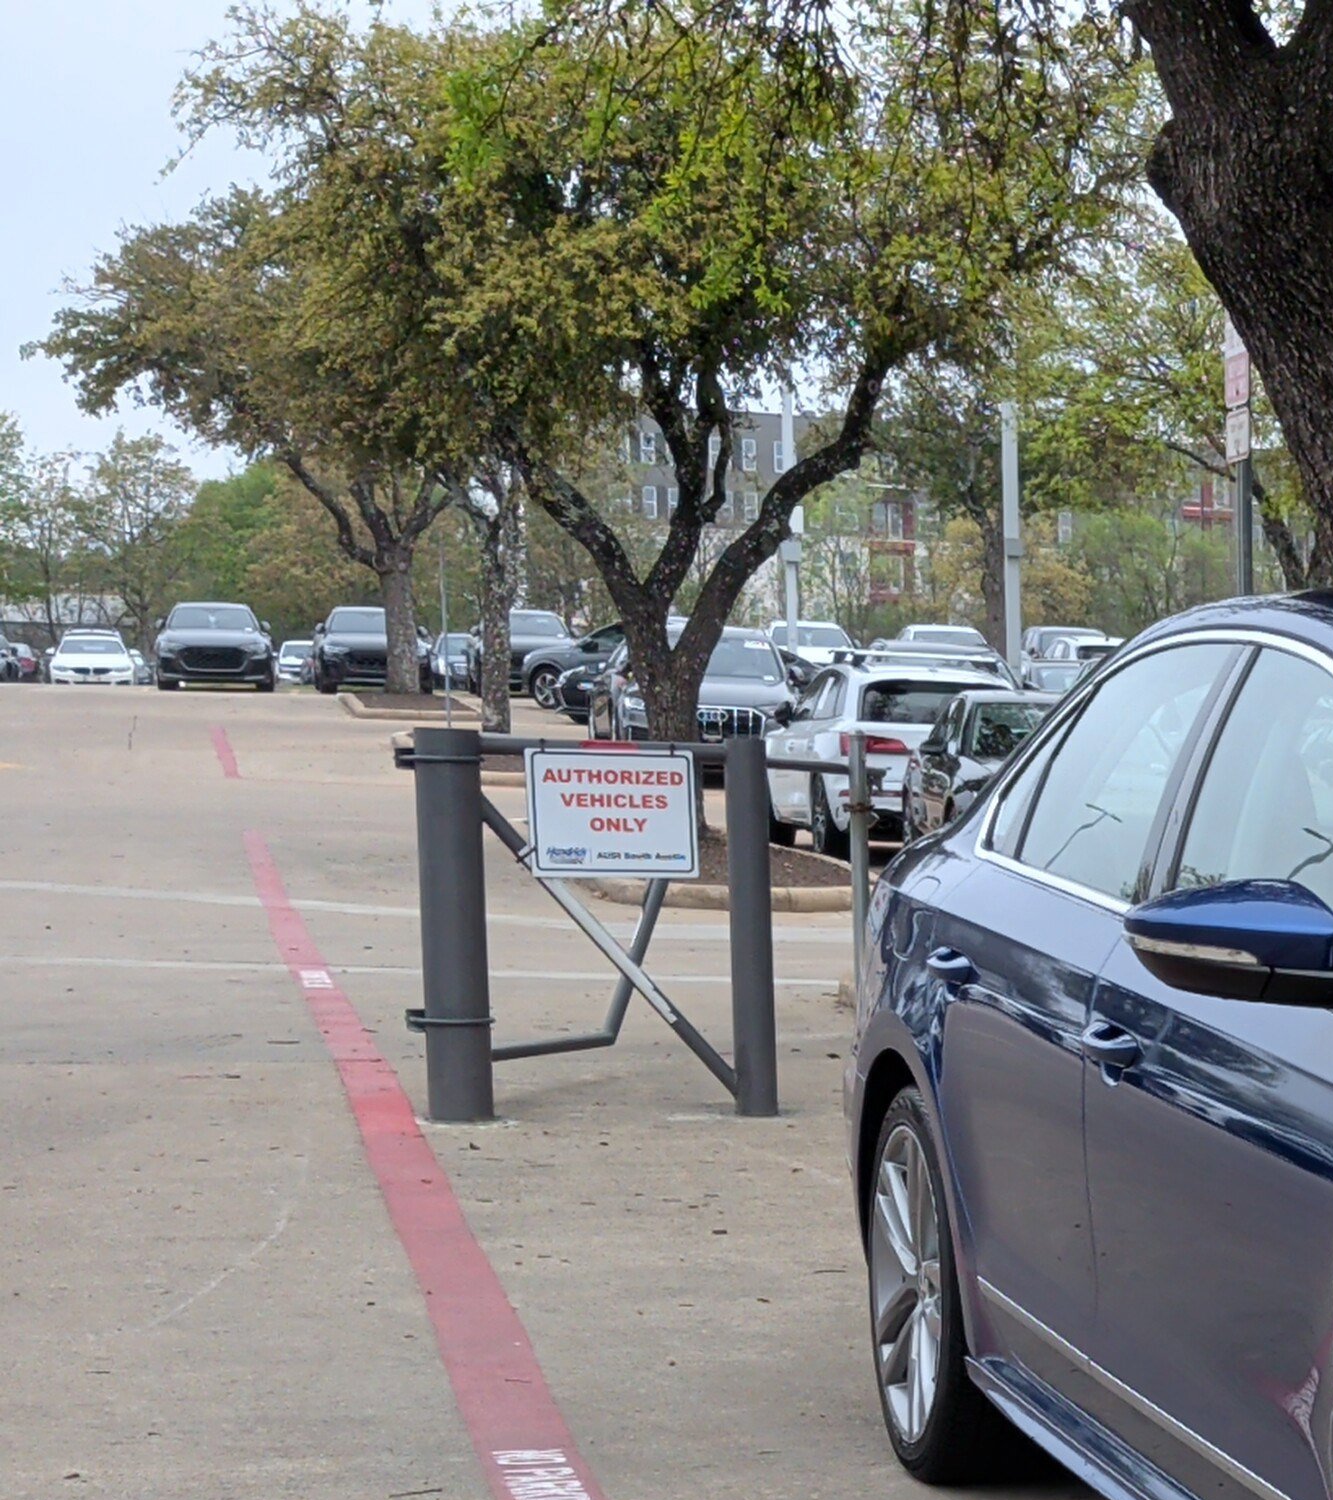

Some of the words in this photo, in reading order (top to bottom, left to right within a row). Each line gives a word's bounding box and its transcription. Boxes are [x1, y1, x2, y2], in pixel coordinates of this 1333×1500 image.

[543, 769, 684, 786] AUTHORIZED
[561, 793, 668, 809] VEHICLES
[590, 818, 647, 832] ONLY
[492, 1449, 566, 1465] NO
